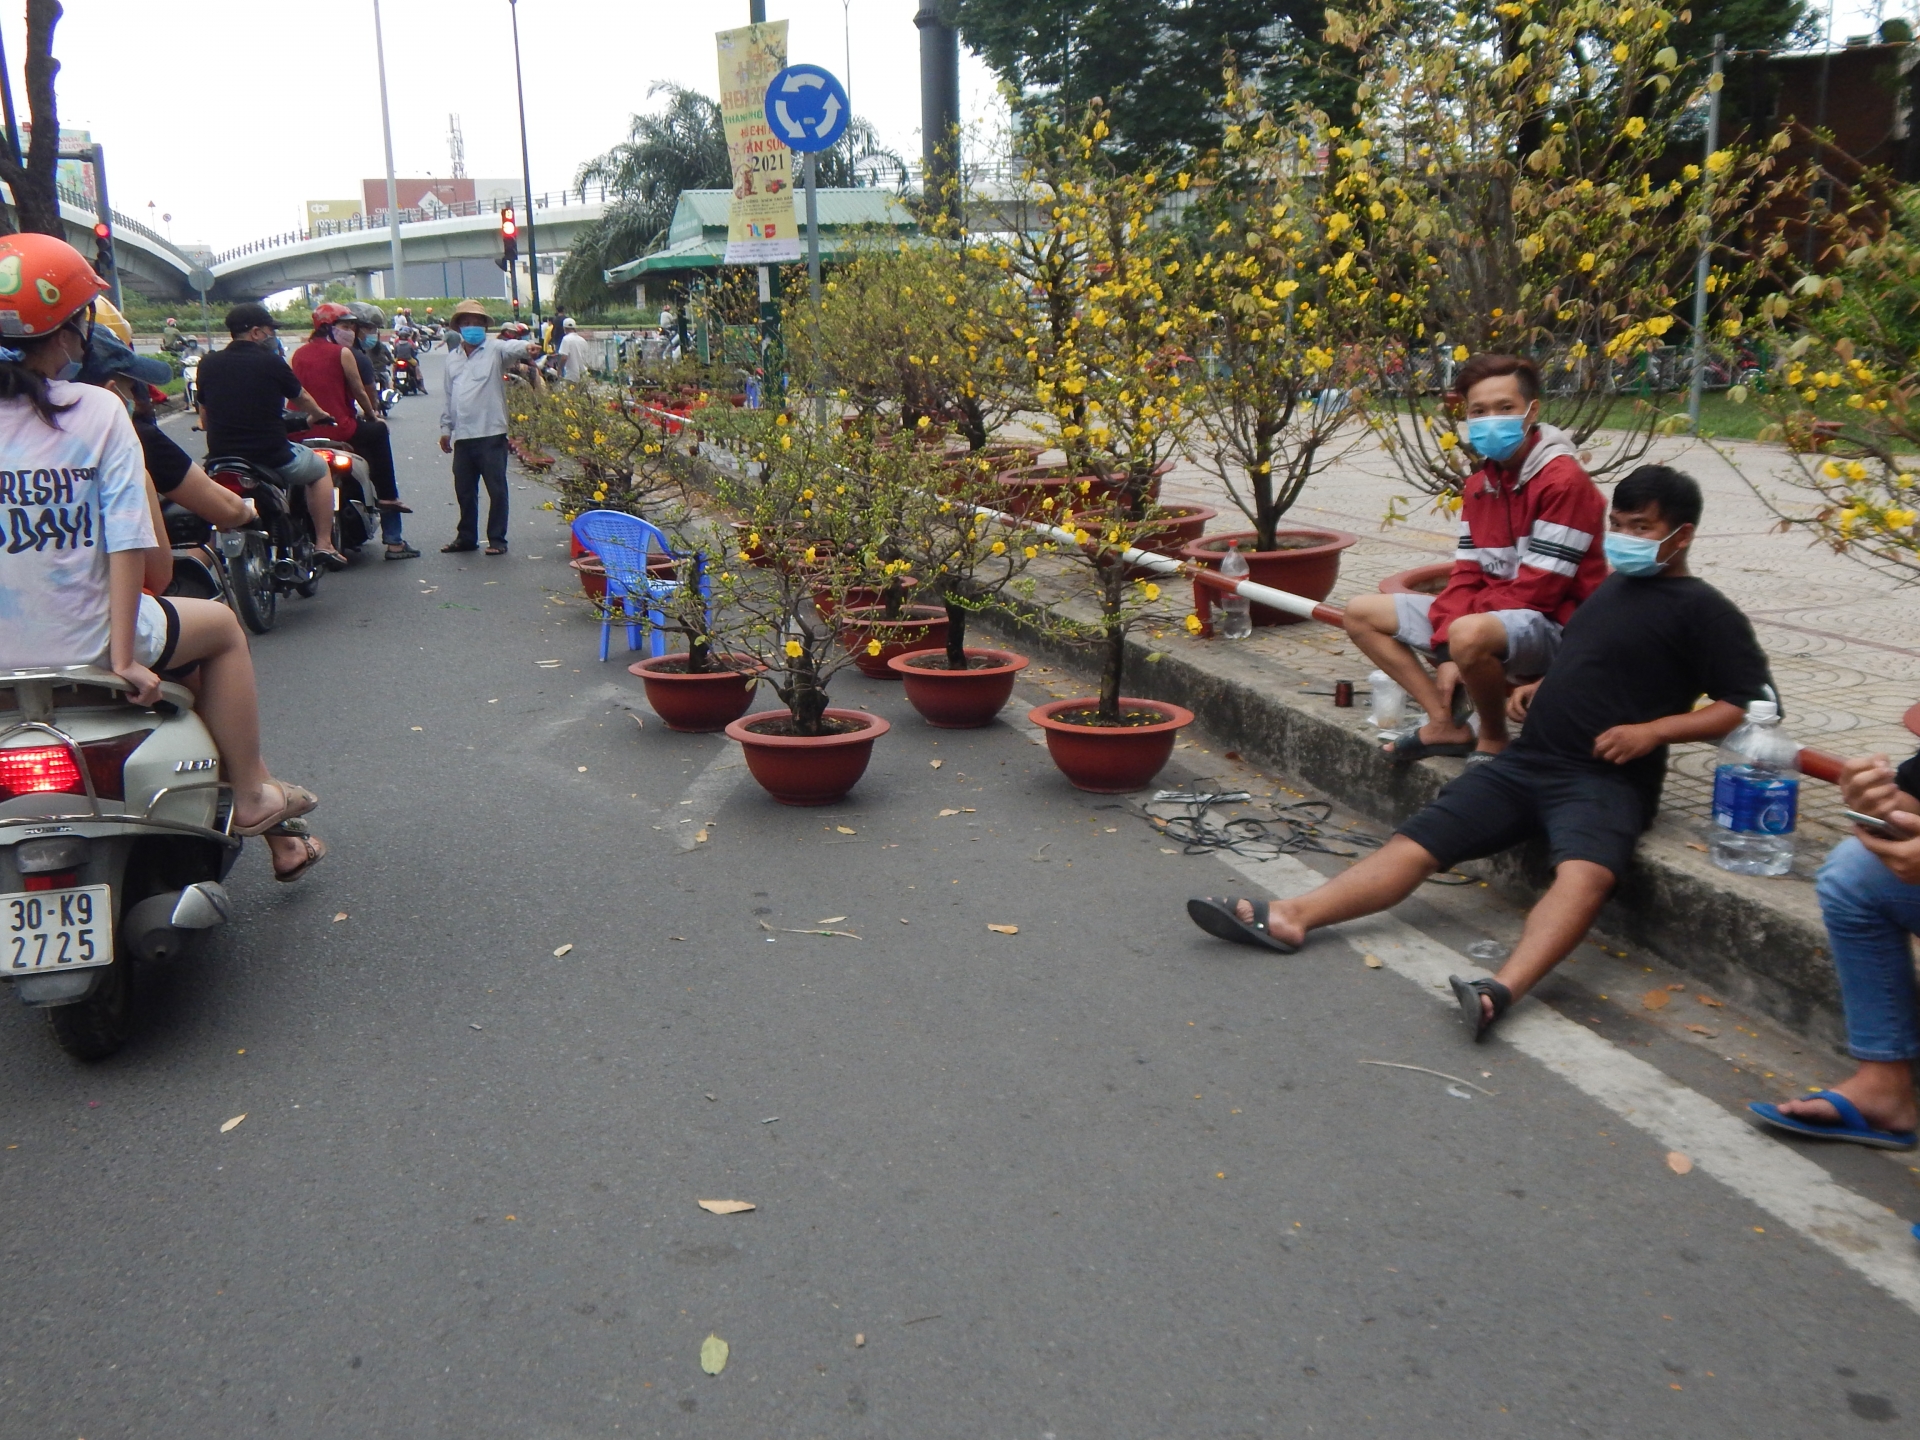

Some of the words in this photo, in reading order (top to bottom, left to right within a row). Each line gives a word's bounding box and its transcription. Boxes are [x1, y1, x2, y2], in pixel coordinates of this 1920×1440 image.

[751, 153, 785, 173] 2021
[0, 467, 73, 506] RESH
[0, 501, 94, 554] DAY!
[10, 893, 93, 932] 30-K9
[12, 928, 94, 969] 2725
